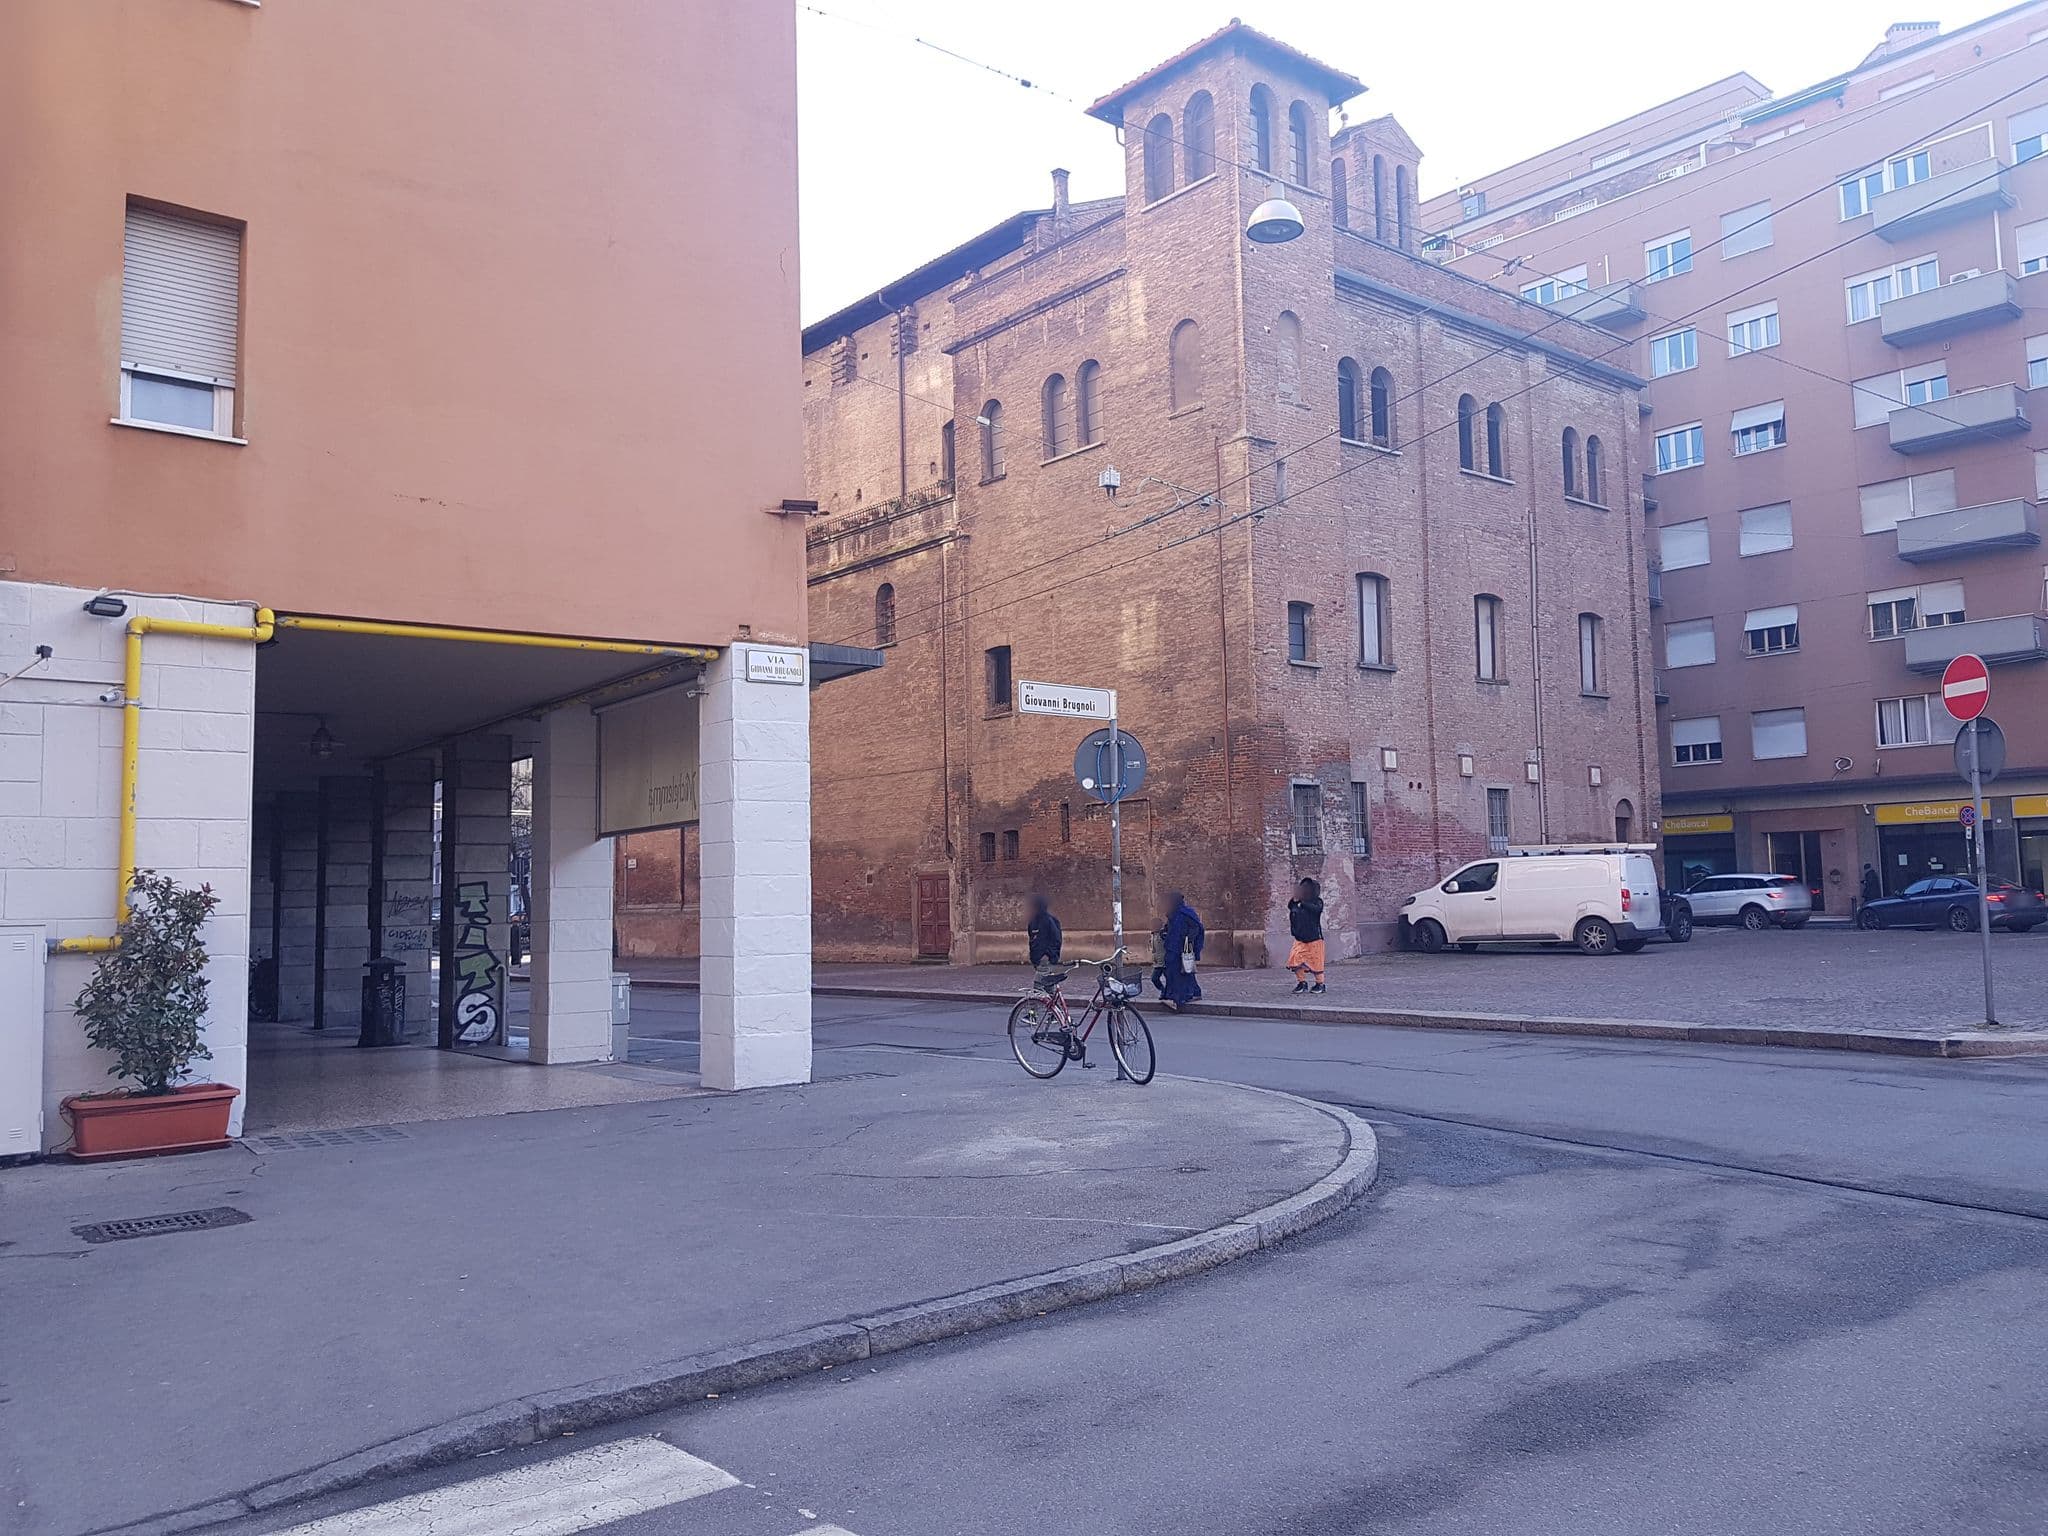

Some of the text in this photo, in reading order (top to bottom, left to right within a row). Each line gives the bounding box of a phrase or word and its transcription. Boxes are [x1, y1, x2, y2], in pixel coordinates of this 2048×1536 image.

[767, 655, 785, 664] VIA
[1026, 683, 1034, 691] via
[1025, 694, 1095, 712] Giovanni Brugnoli
